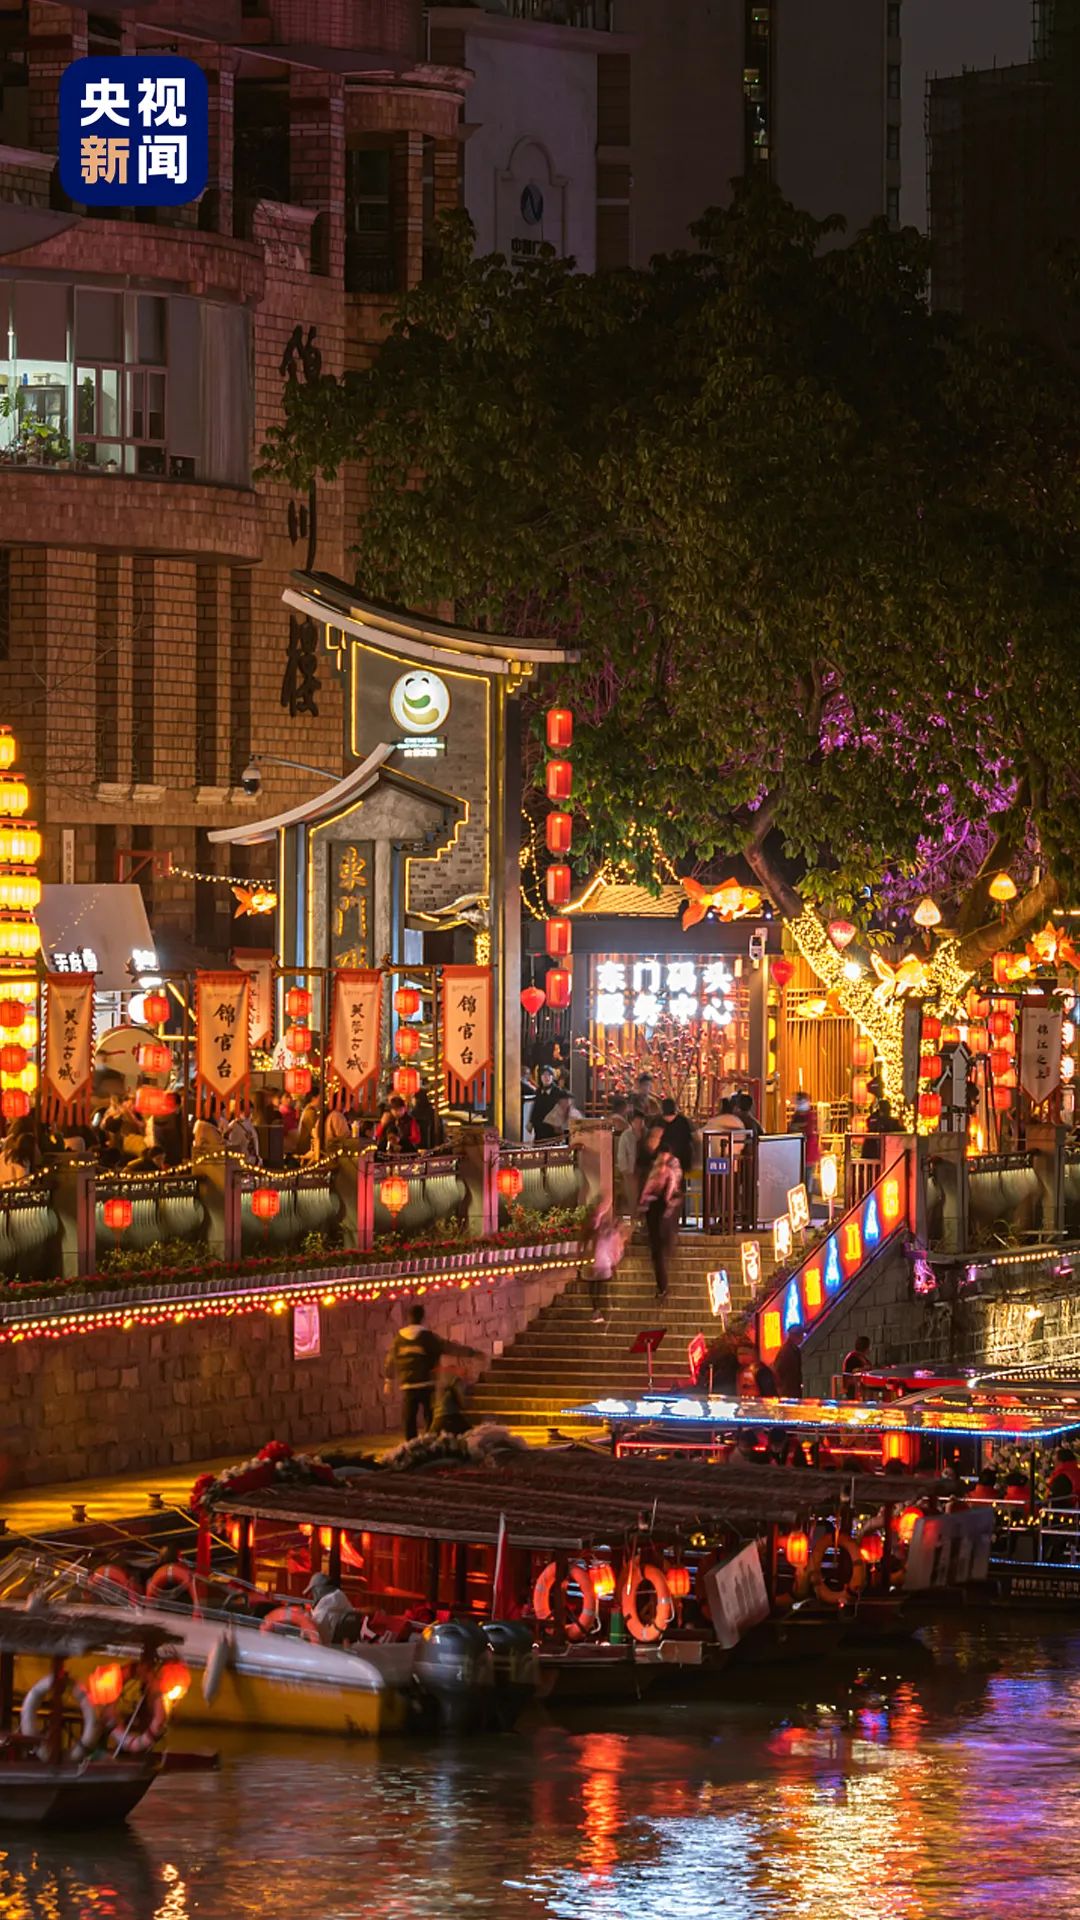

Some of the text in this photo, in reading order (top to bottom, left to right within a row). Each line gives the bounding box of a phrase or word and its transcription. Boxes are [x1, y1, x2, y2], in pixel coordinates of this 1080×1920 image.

[596, 993, 734, 1026] 服务中心
[597, 961, 733, 993] 东门码头
[58, 1008, 78, 1085] 芙蓉古城
[213, 1003, 236, 1078] 锦官台
[346, 1003, 365, 1074] 芙蓉古城
[457, 994, 477, 1064] 锦官台
